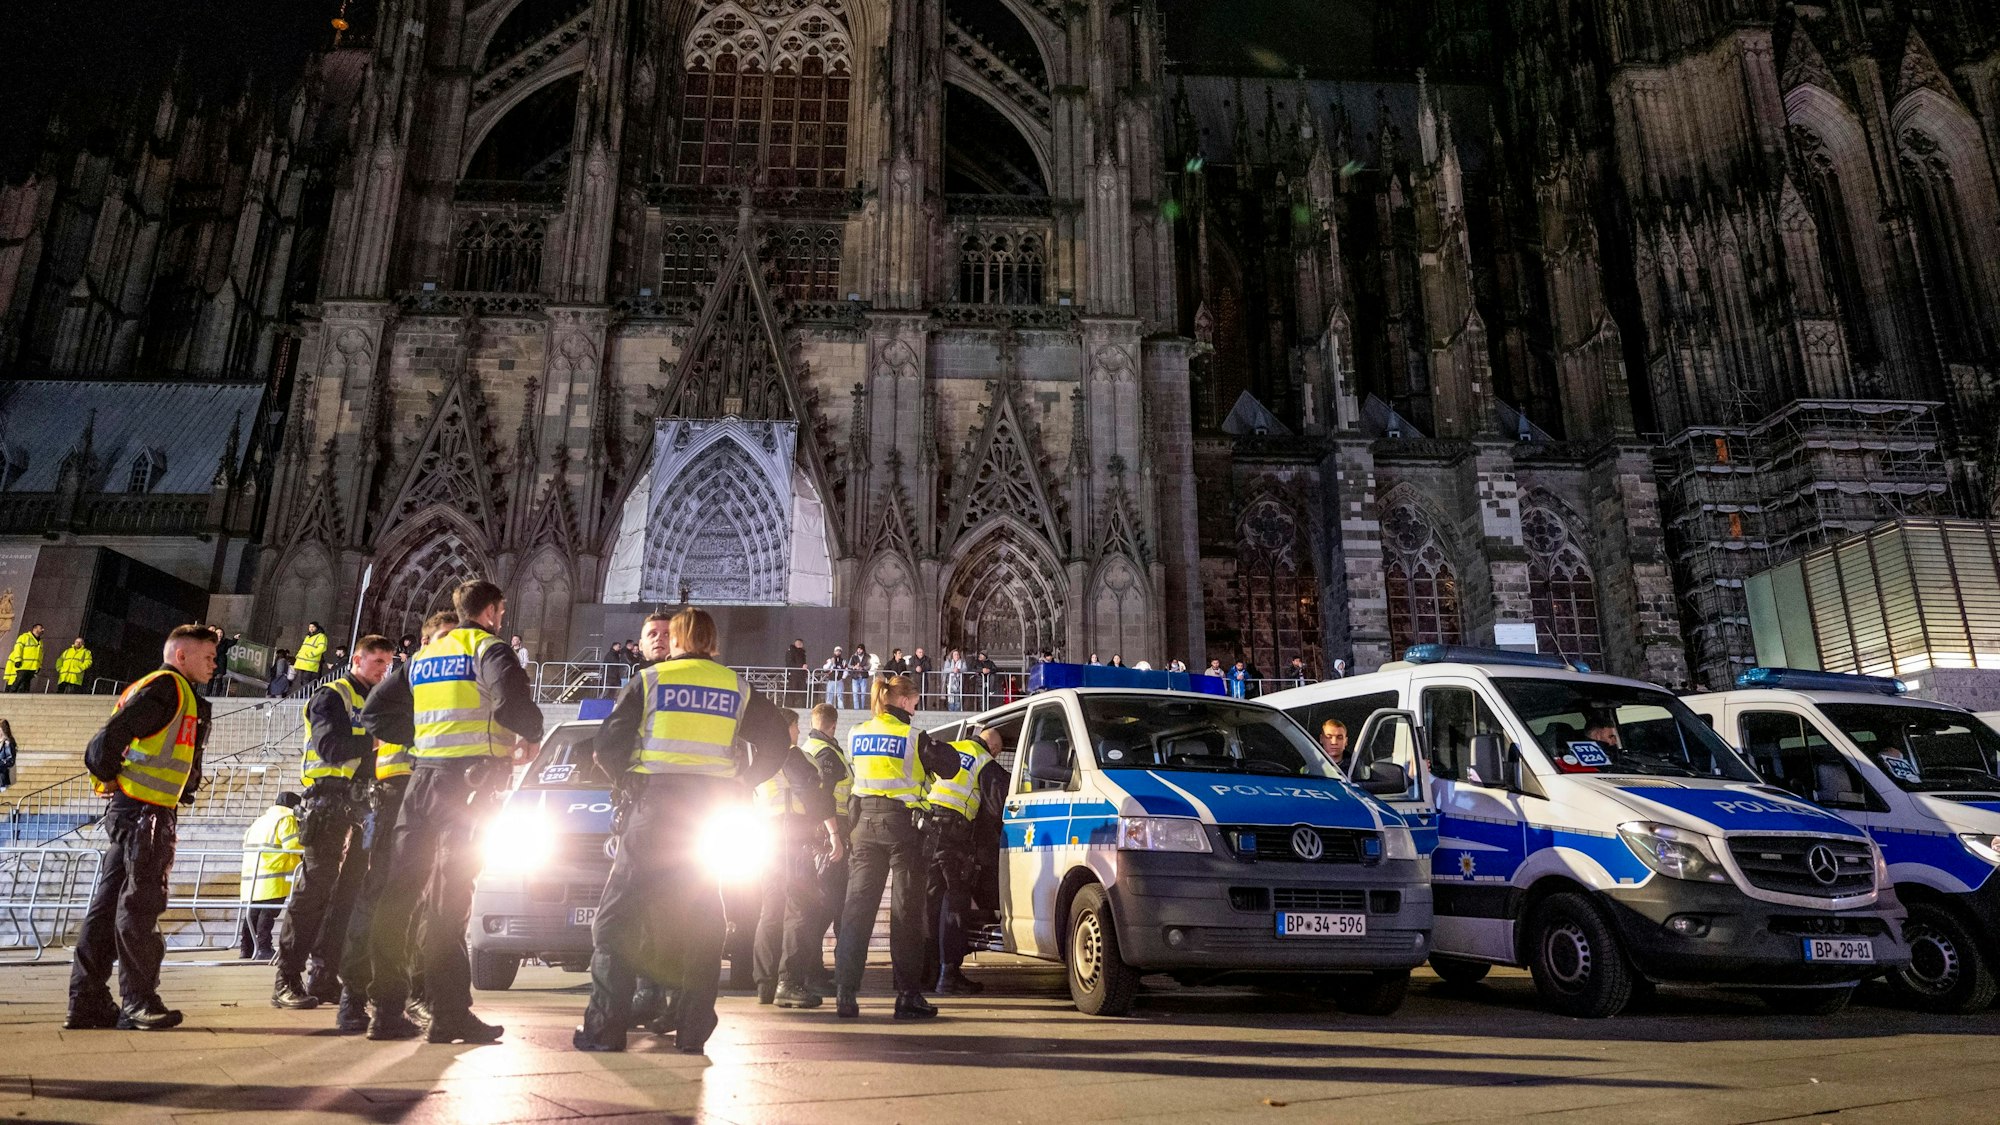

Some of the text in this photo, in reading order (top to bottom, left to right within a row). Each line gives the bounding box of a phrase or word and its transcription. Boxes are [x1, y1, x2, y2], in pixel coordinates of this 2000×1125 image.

[413, 657, 471, 681] POLIZEI
[664, 688, 735, 713] POLIZEI
[854, 737, 901, 754] POLIZEI
[1574, 745, 1599, 753] STA
[1582, 754, 1604, 762] 224
[1209, 784, 1340, 801] POLIZEI
[576, 909, 595, 923] BP
[1287, 915, 1304, 932] BP
[1314, 916, 1363, 933] 34-596
[1815, 942, 1832, 958] BP
[1840, 942, 1871, 959] 29-81
